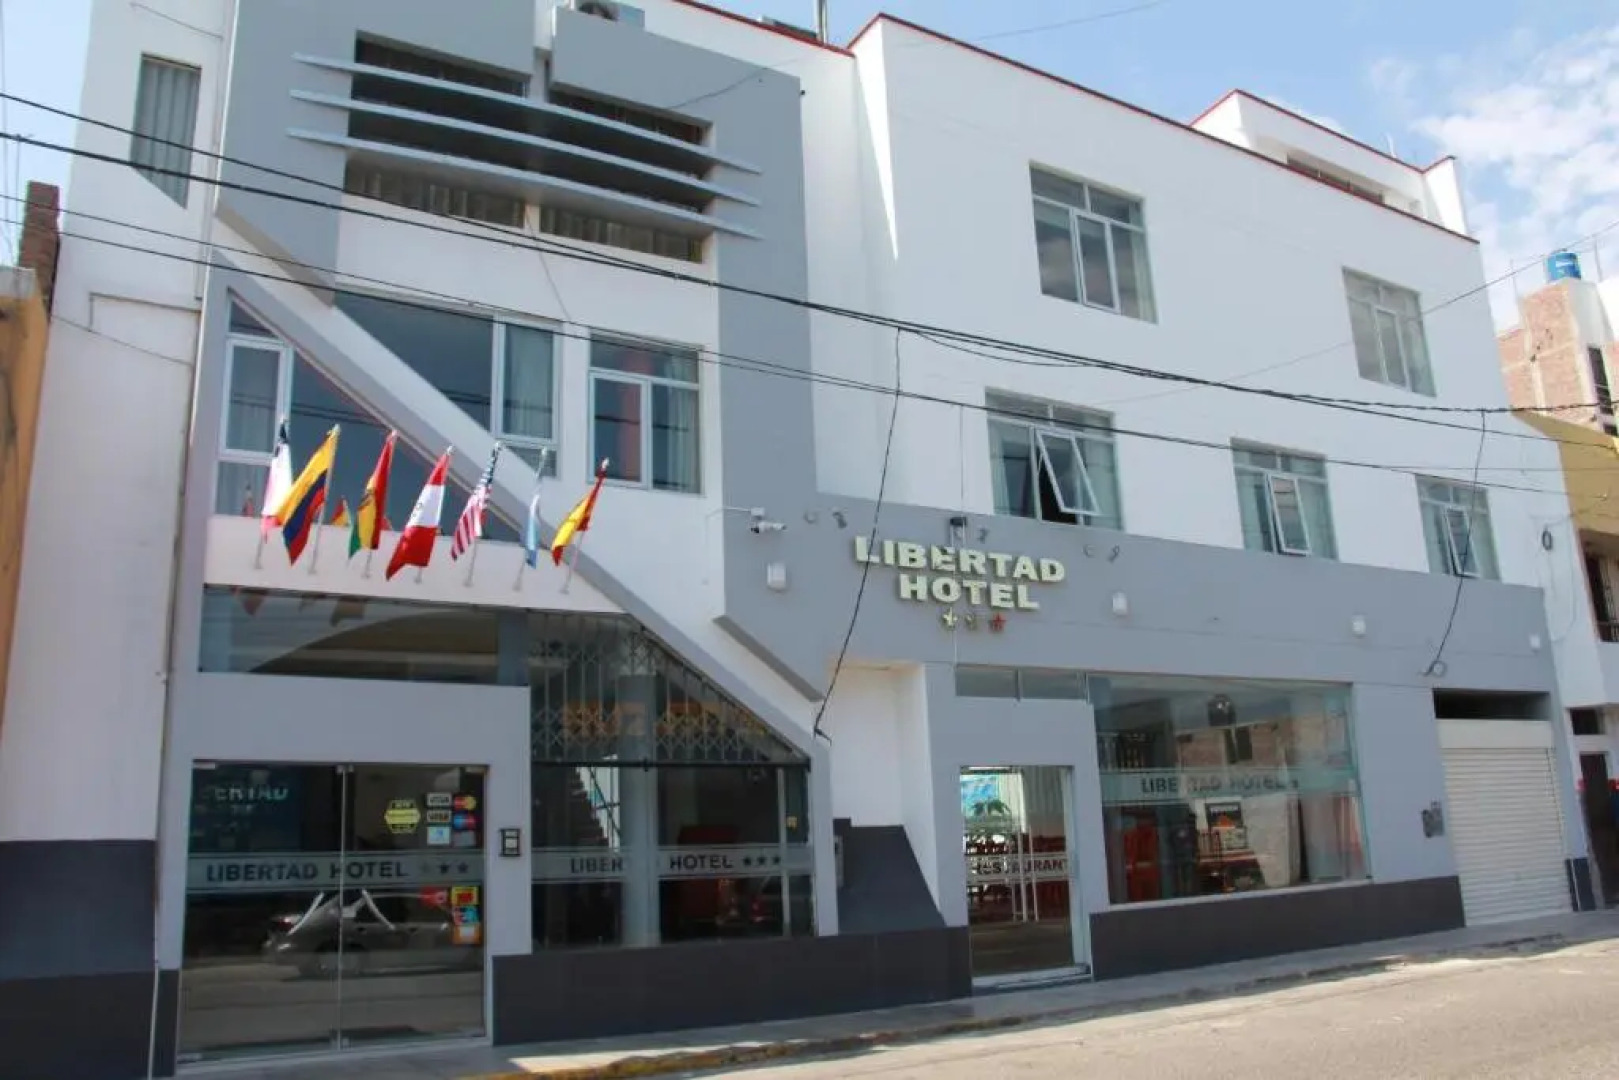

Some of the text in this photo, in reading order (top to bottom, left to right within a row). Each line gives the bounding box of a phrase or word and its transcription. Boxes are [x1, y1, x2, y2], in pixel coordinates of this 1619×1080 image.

[854, 536, 1066, 582] LIBERTAD
[899, 574, 1040, 609] HOTEL
[1140, 777, 1222, 795] LIBETAD
[206, 859, 408, 883] LIBERTAD HOTEL
[570, 854, 734, 874] LIBER HOTEL
